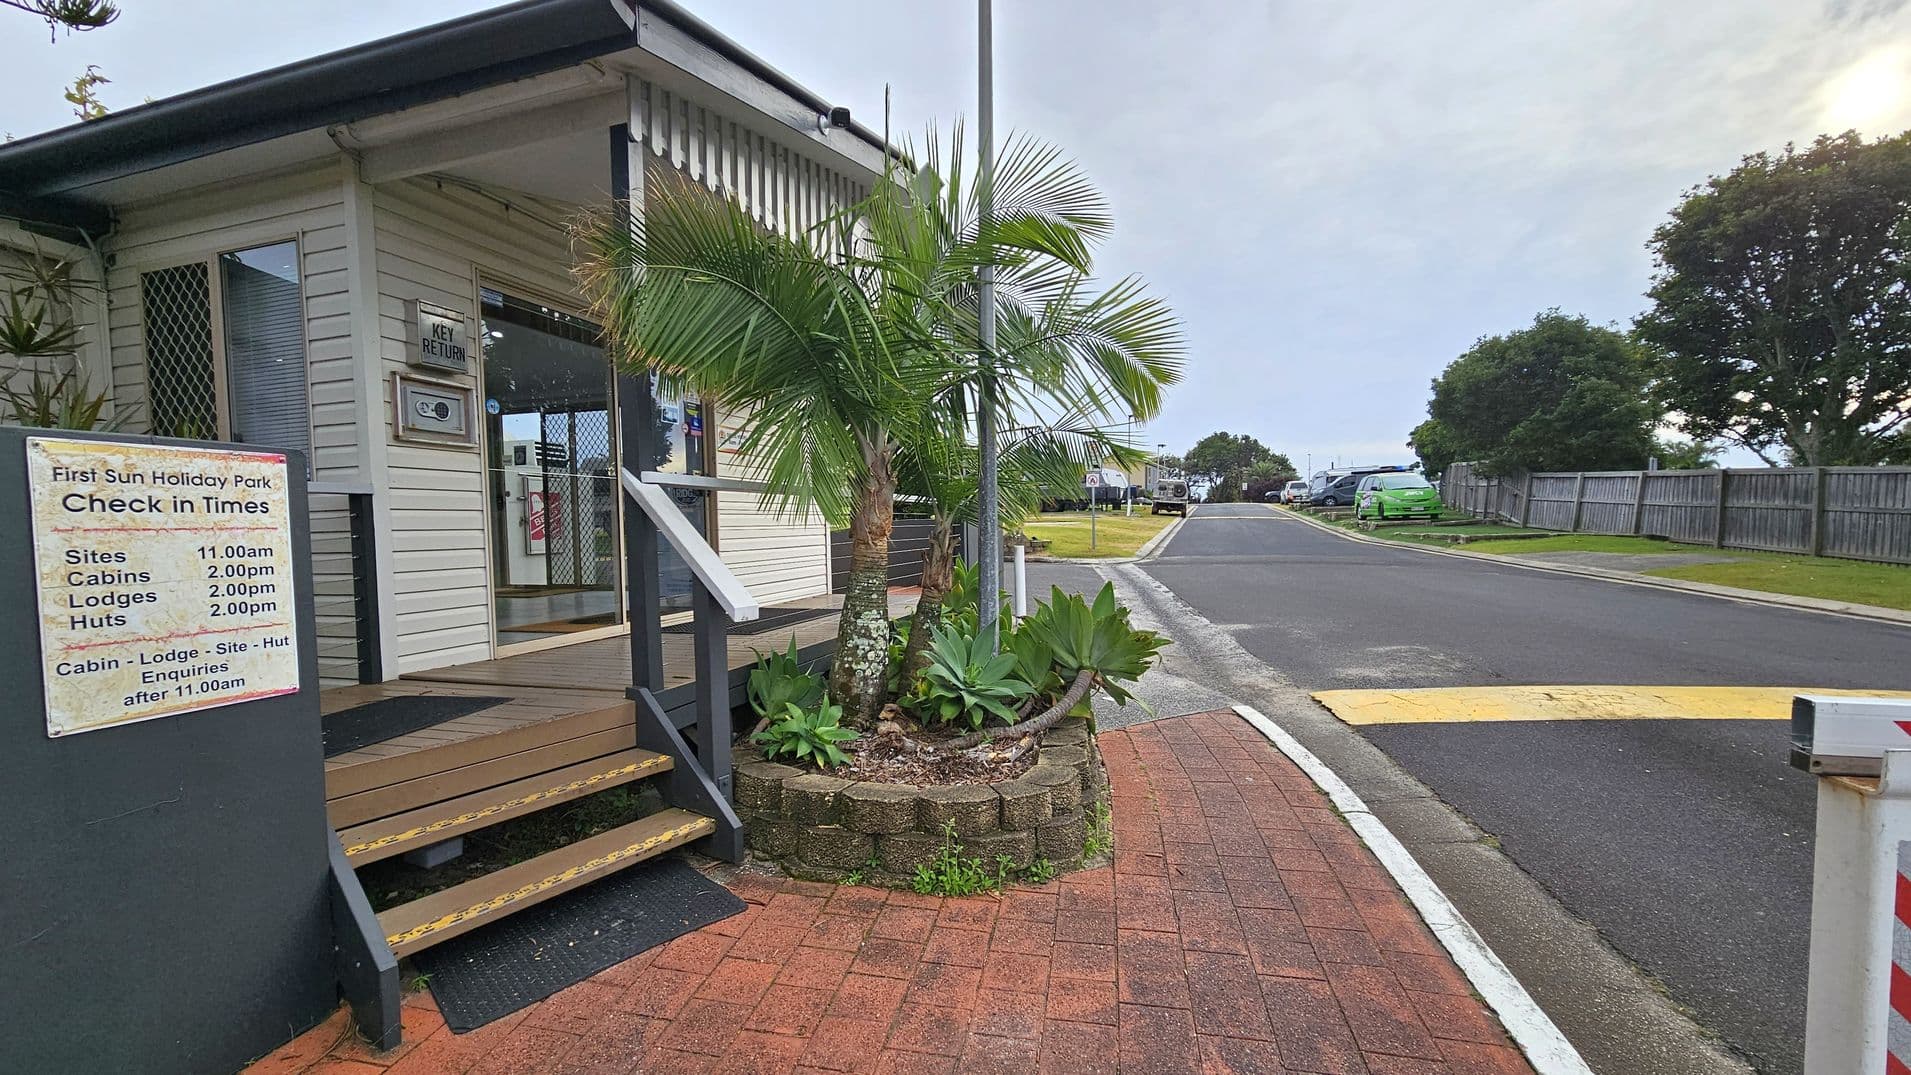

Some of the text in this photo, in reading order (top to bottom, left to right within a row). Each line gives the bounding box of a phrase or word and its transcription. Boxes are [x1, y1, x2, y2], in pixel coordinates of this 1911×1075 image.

[432, 323, 454, 342] KEY
[423, 338, 465, 362] RETURN
[52, 466, 272, 489] First Sun Holiday Park
[61, 493, 270, 514] Check in Times
[65, 545, 273, 565] Sites 11.00am
[67, 563, 274, 587] Cabins 2.00pm
[68, 582, 276, 609] Lodges 2.00pm
[70, 601, 277, 631] Huts 2.00pm
[56, 657, 119, 676] Cabin
[140, 649, 199, 666] Lodge
[215, 642, 248, 655] Site
[263, 636, 290, 649] Hut
[141, 661, 229, 684] Enquiries
[123, 676, 245, 707] after 11.00am
